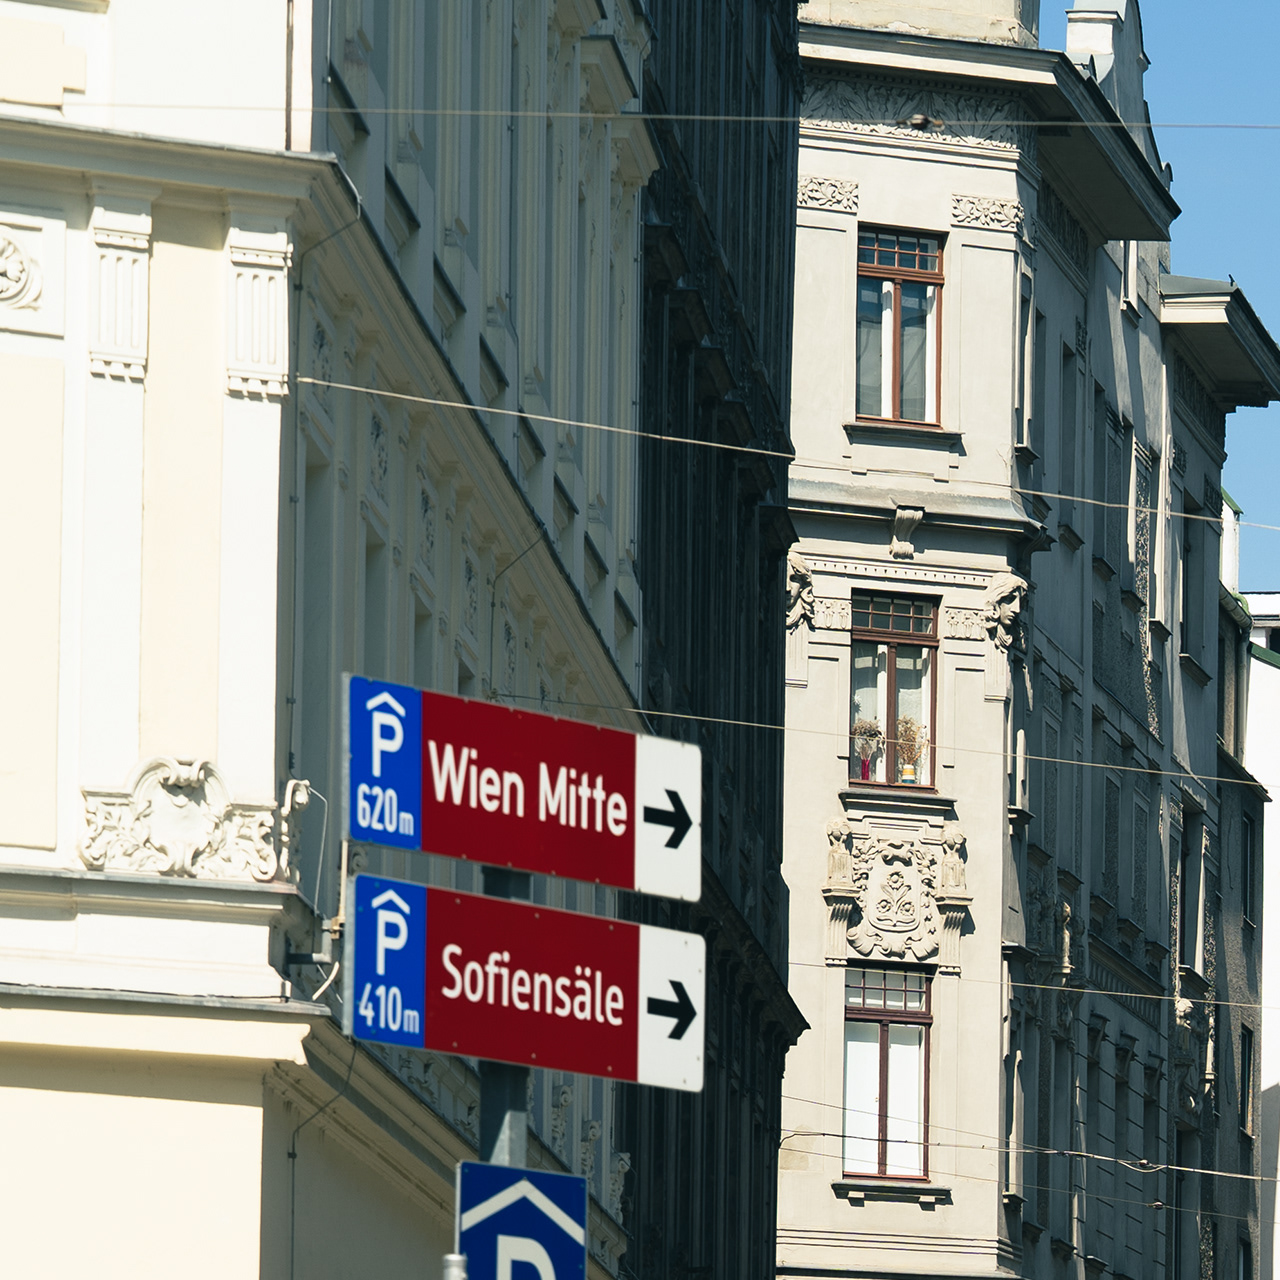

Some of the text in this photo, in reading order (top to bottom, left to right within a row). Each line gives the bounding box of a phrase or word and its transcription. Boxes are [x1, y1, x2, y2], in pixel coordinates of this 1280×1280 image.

[372, 710, 405, 778] P
[427, 739, 628, 837] Wien Mitte
[376, 908, 409, 976] P
[441, 943, 624, 1027] Sofiensäle
